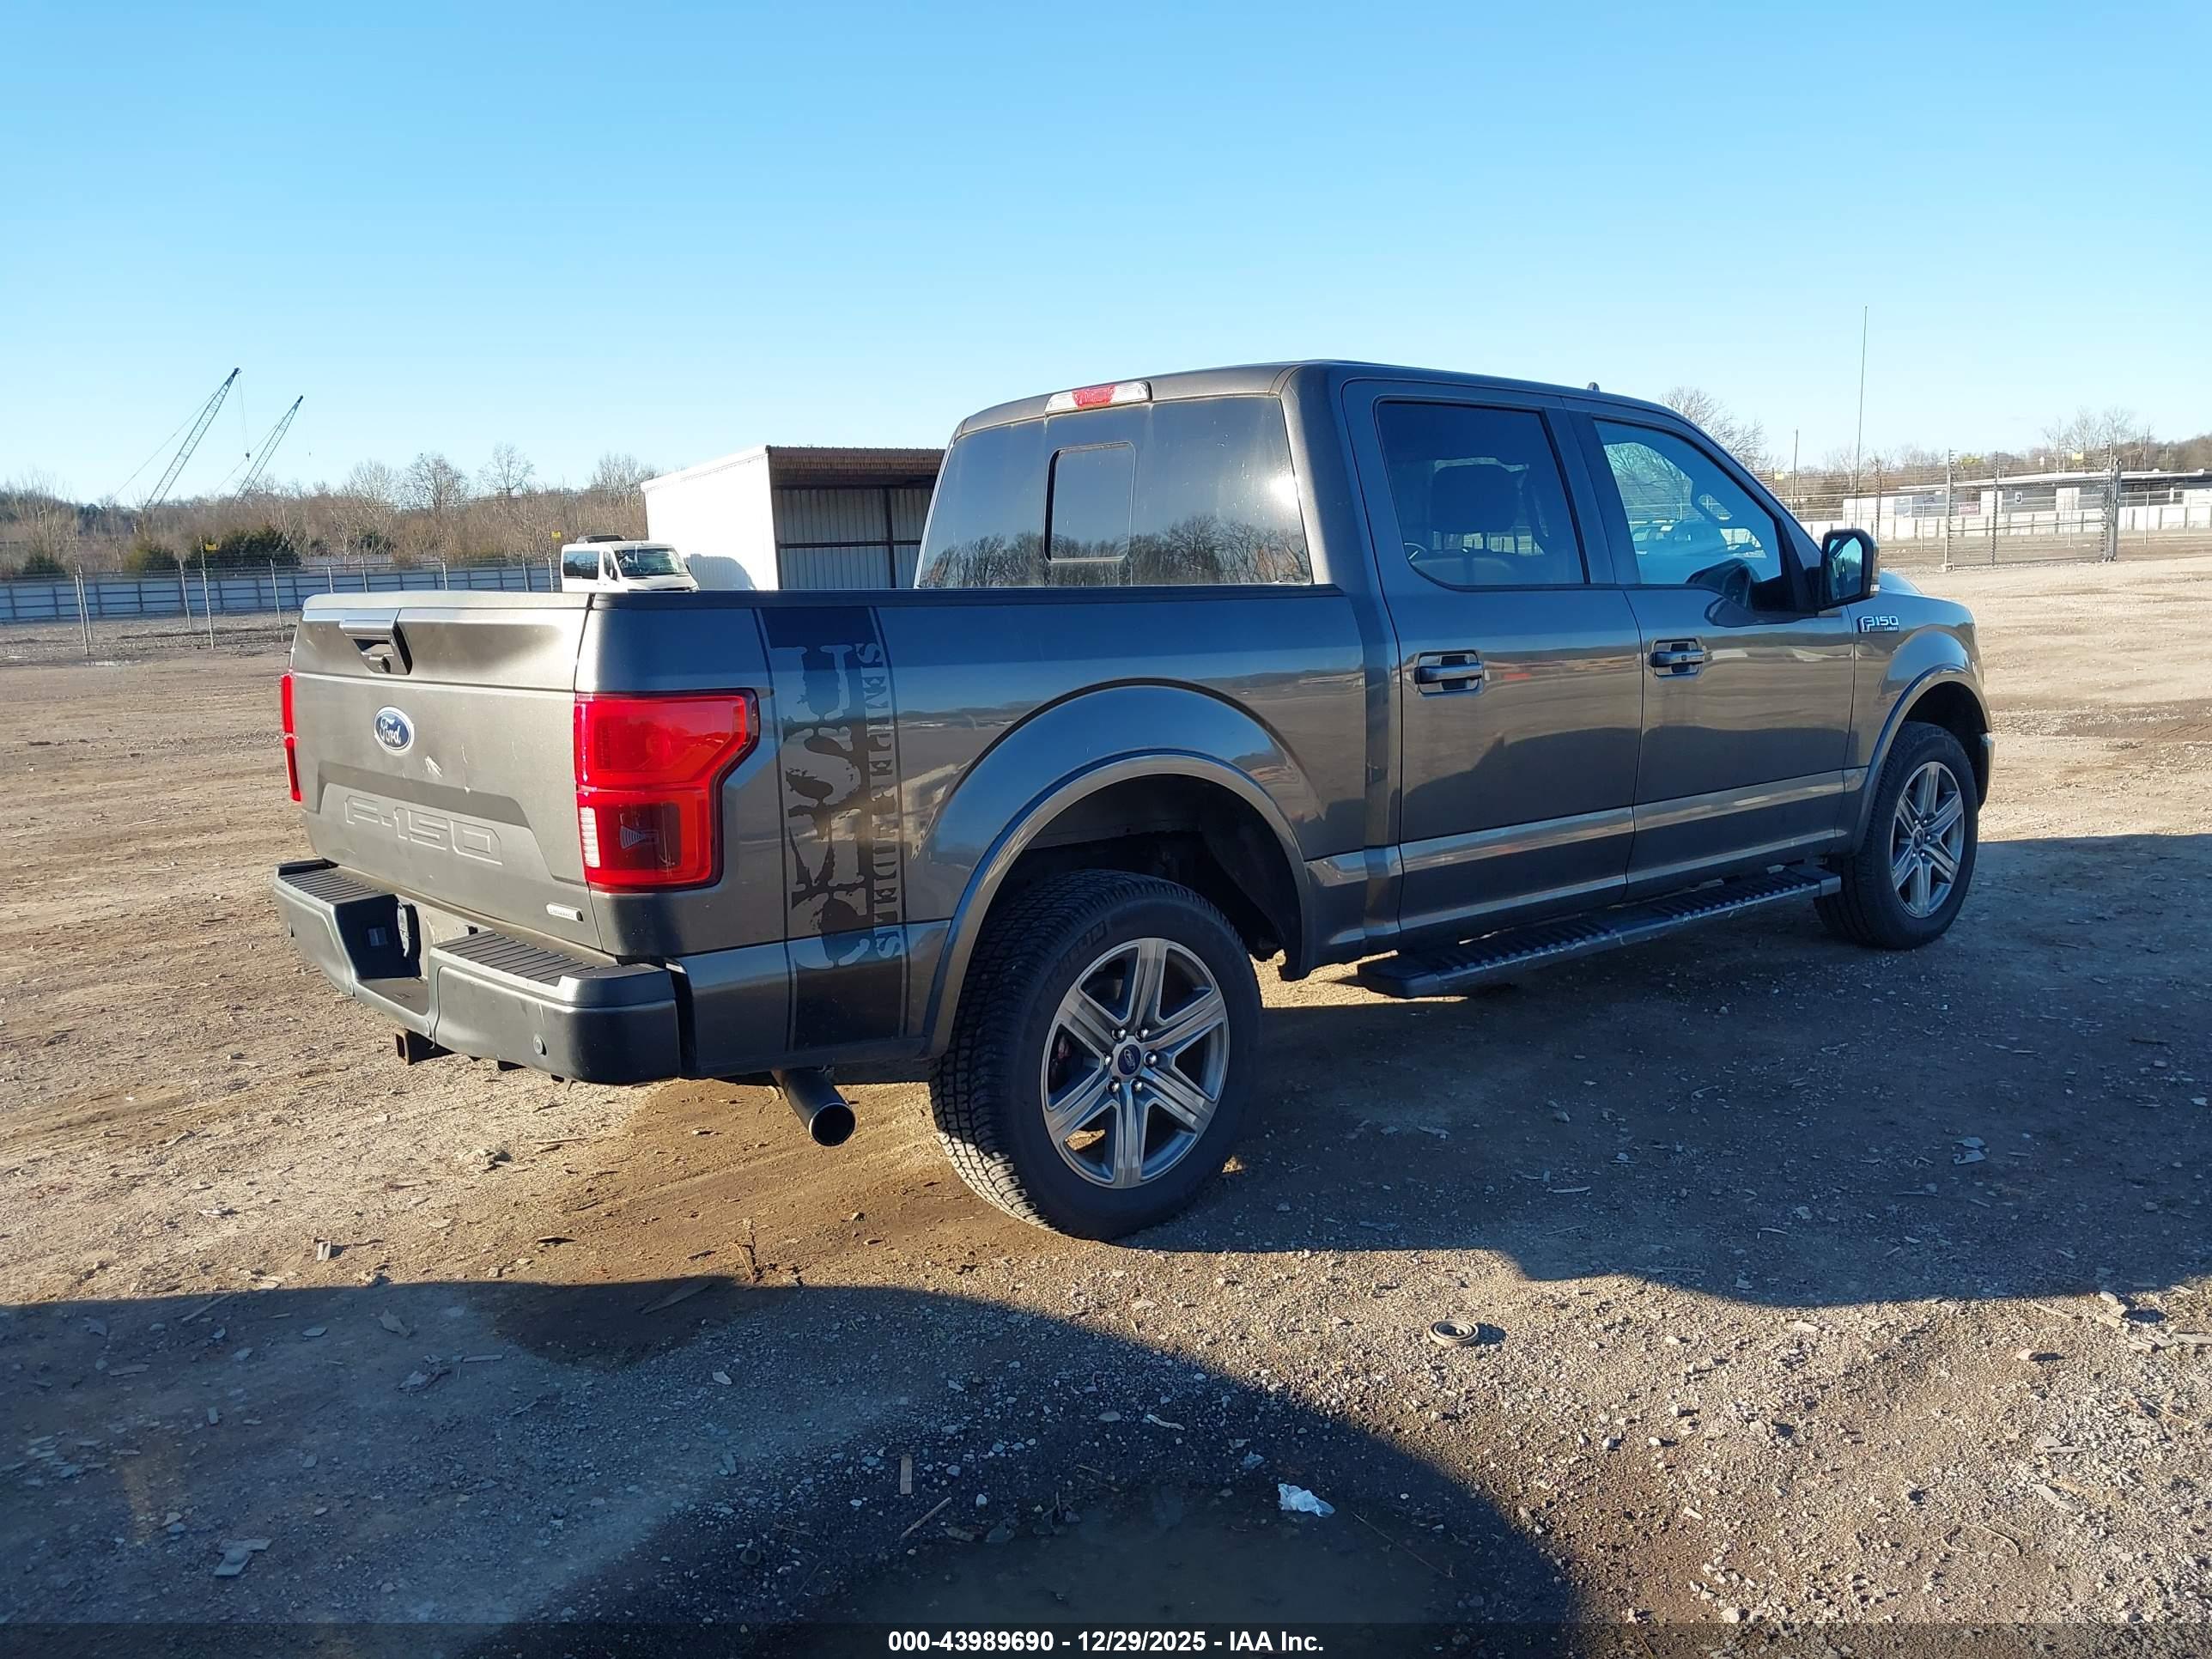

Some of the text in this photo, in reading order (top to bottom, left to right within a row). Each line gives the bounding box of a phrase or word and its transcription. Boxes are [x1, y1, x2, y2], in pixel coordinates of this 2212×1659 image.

[1860, 616, 1899, 632] F150
[380, 716, 402, 744] Ford
[344, 795, 503, 866] F-150
[773, 645, 869, 969] USMC
[856, 643, 901, 959] SEMPER FIDELIS
